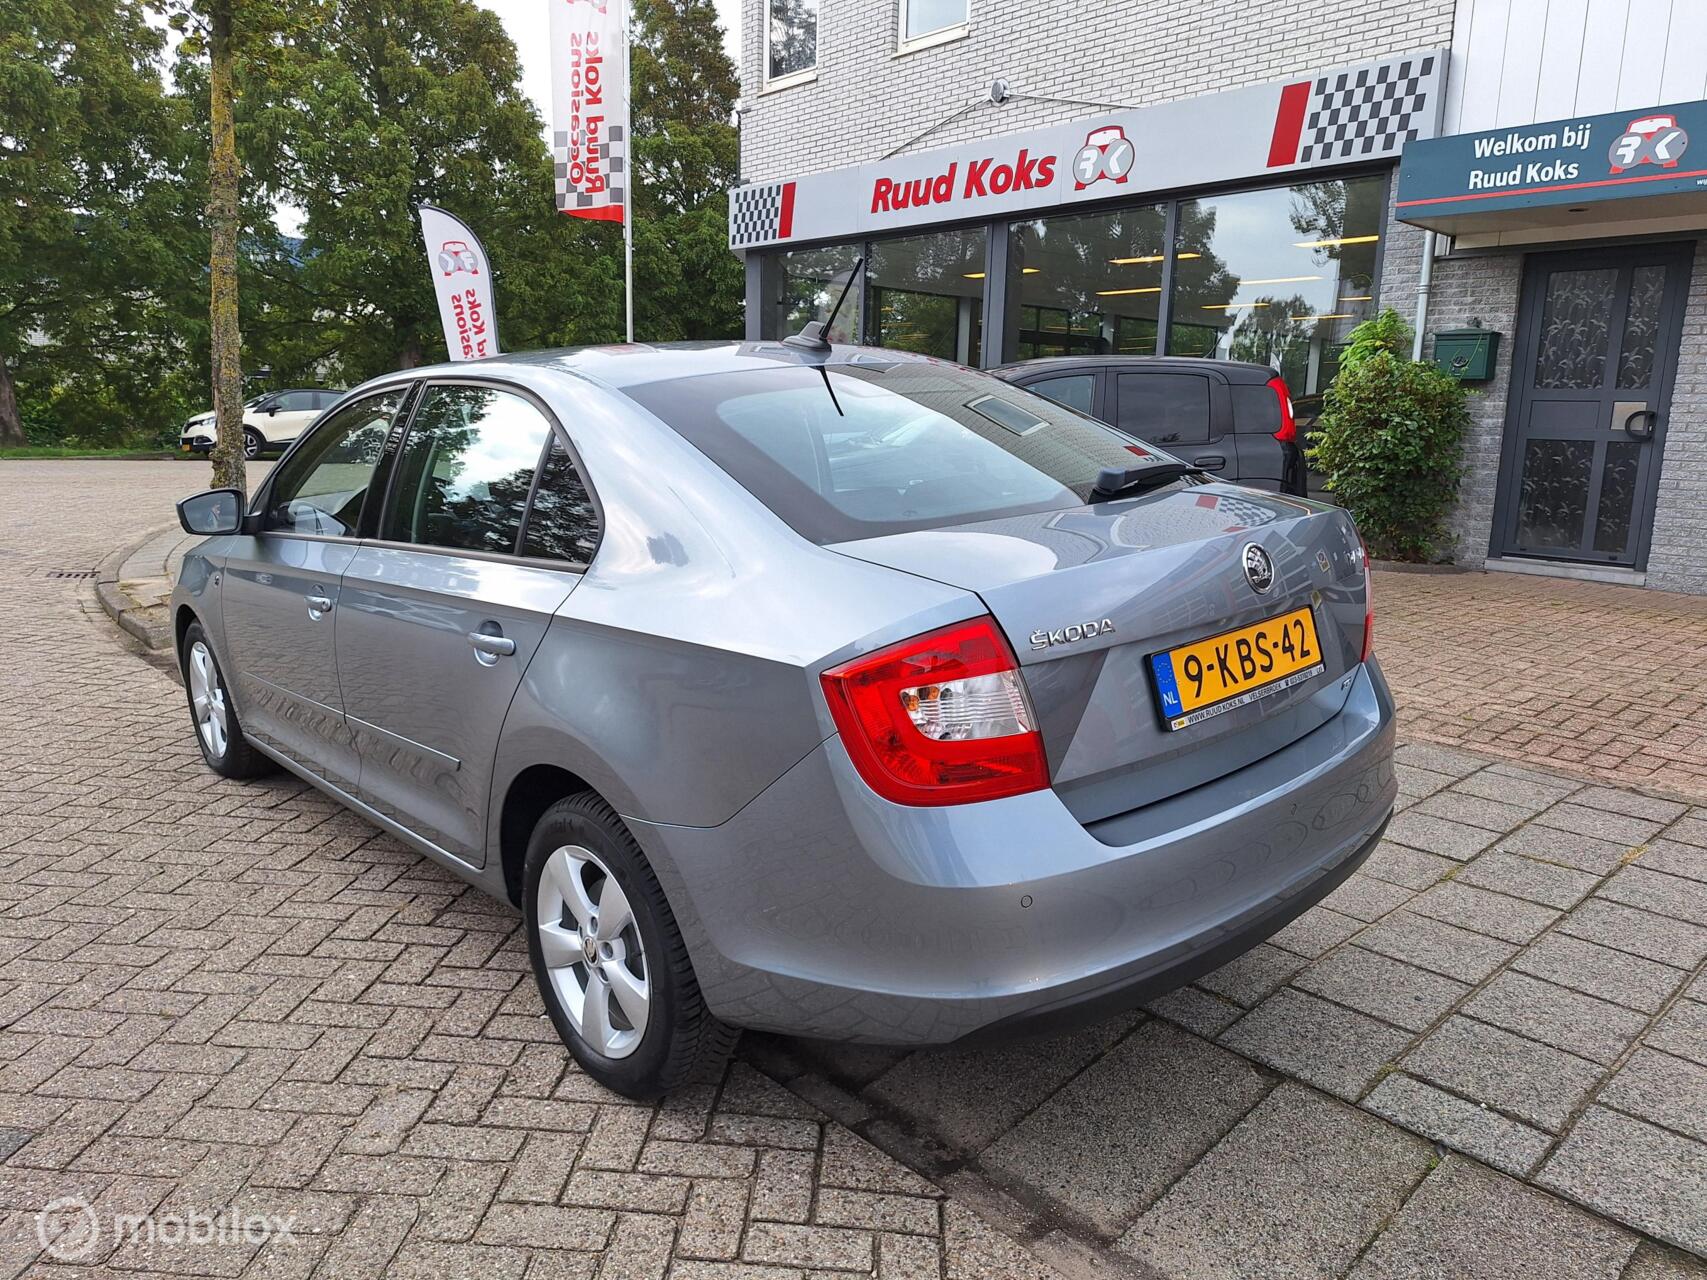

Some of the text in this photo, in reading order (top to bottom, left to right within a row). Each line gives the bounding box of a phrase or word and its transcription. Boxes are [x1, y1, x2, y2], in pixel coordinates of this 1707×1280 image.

[1474, 124, 1592, 159] Welkom bij
[871, 149, 1057, 213] Ruud Koks
[1468, 159, 1580, 190] Ruud Koks
[1184, 619, 1311, 698] 9-KBS-42
[1162, 690, 1178, 707] NL
